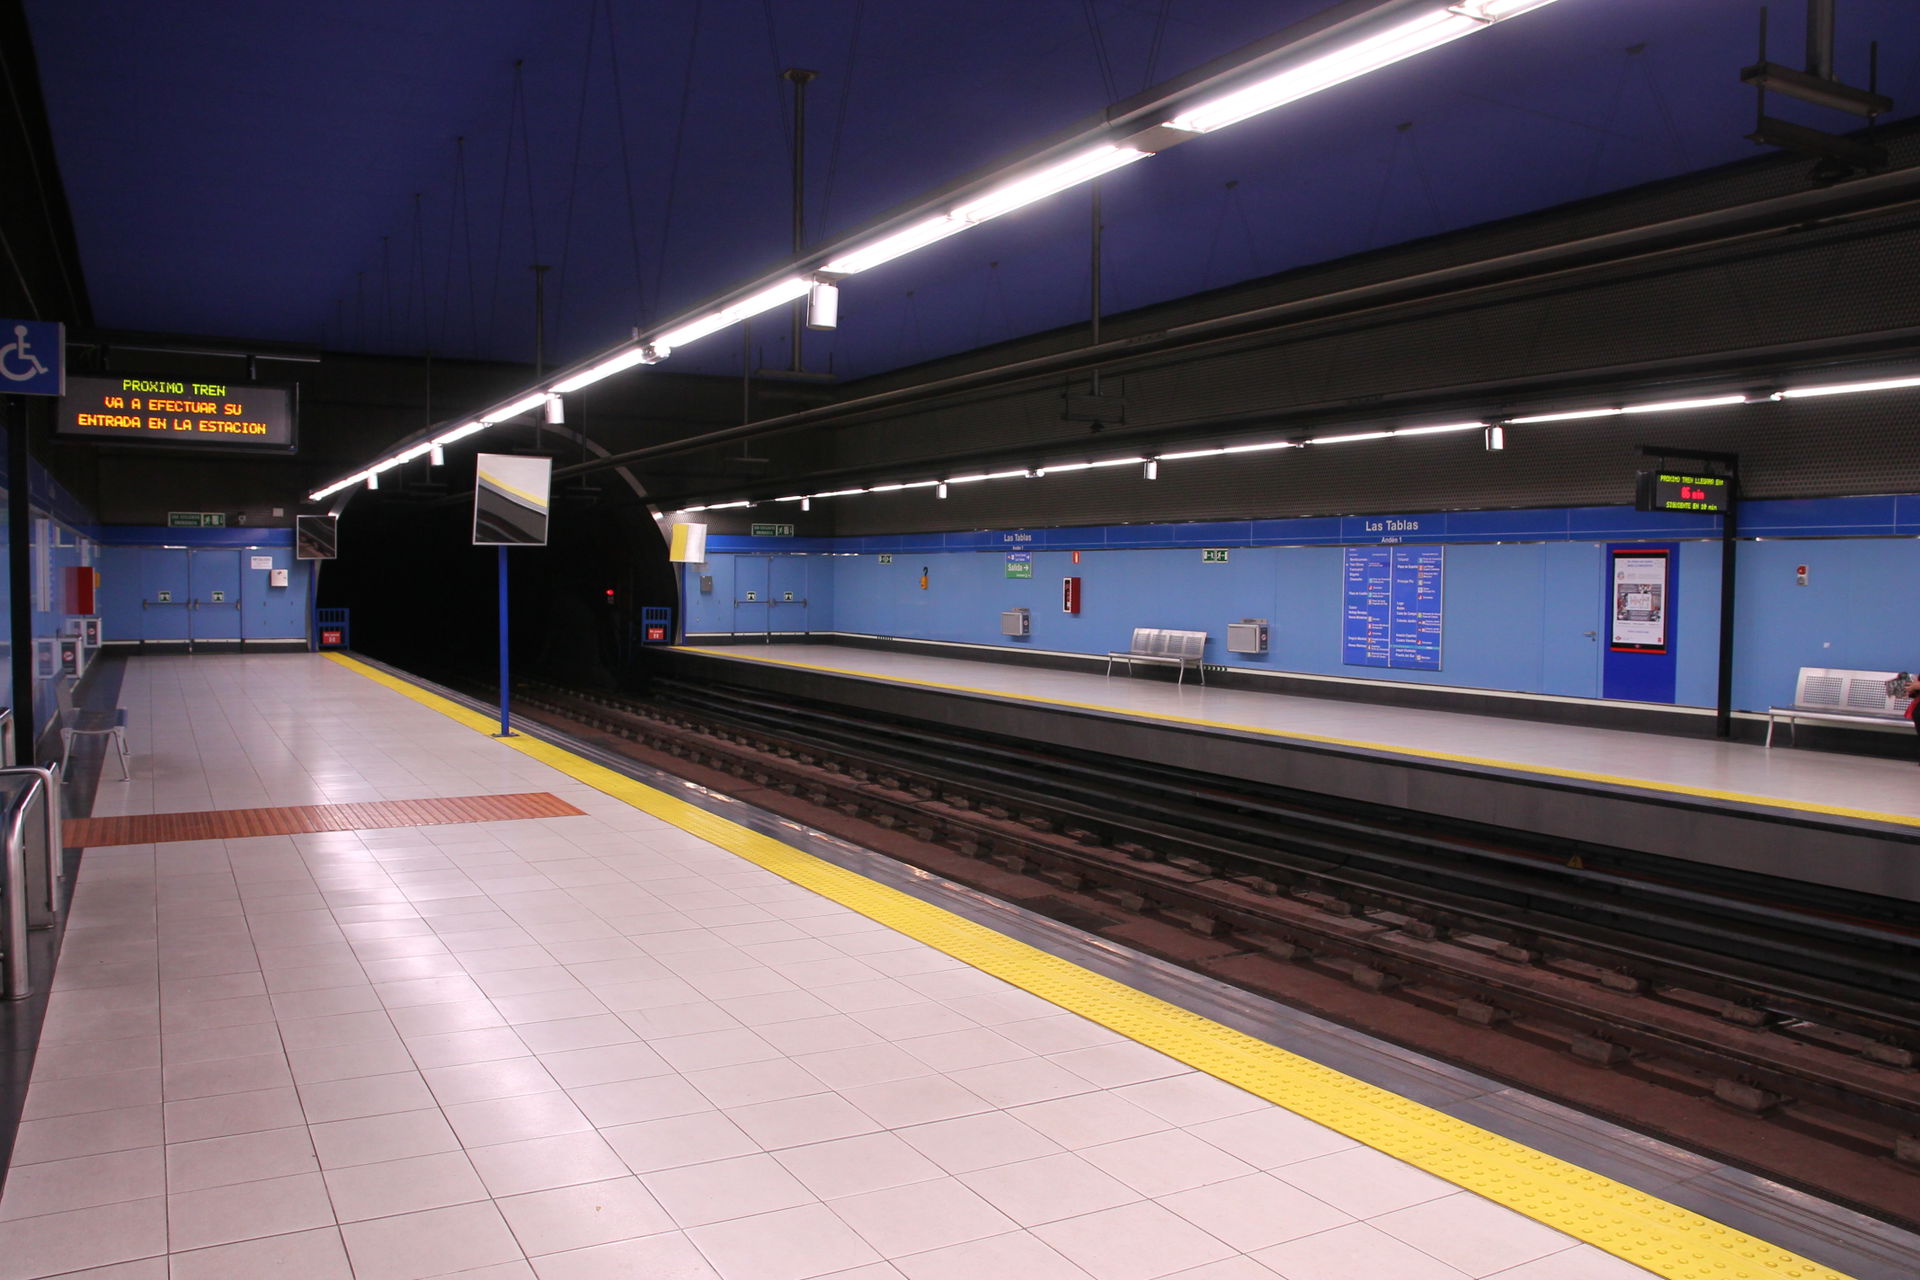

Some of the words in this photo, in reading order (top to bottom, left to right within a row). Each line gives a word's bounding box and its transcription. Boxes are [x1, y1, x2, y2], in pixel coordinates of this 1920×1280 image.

[122, 379, 185, 395] PROXIMO
[191, 383, 226, 397] TREN
[103, 396, 124, 409] VA
[131, 398, 142, 410] A
[148, 399, 217, 415] EFECTUAR
[224, 403, 243, 416] SU
[77, 413, 141, 429] ENTRADA
[148, 417, 167, 430] EN
[173, 418, 192, 432] LA
[199, 420, 267, 435] ESTACION
[1365, 520, 1384, 532] Las
[1385, 519, 1419, 531] Tablas
[1003, 533, 1014, 542] Las
[1014, 533, 1032, 542] Tablas
[1007, 563, 1023, 572] Salida
